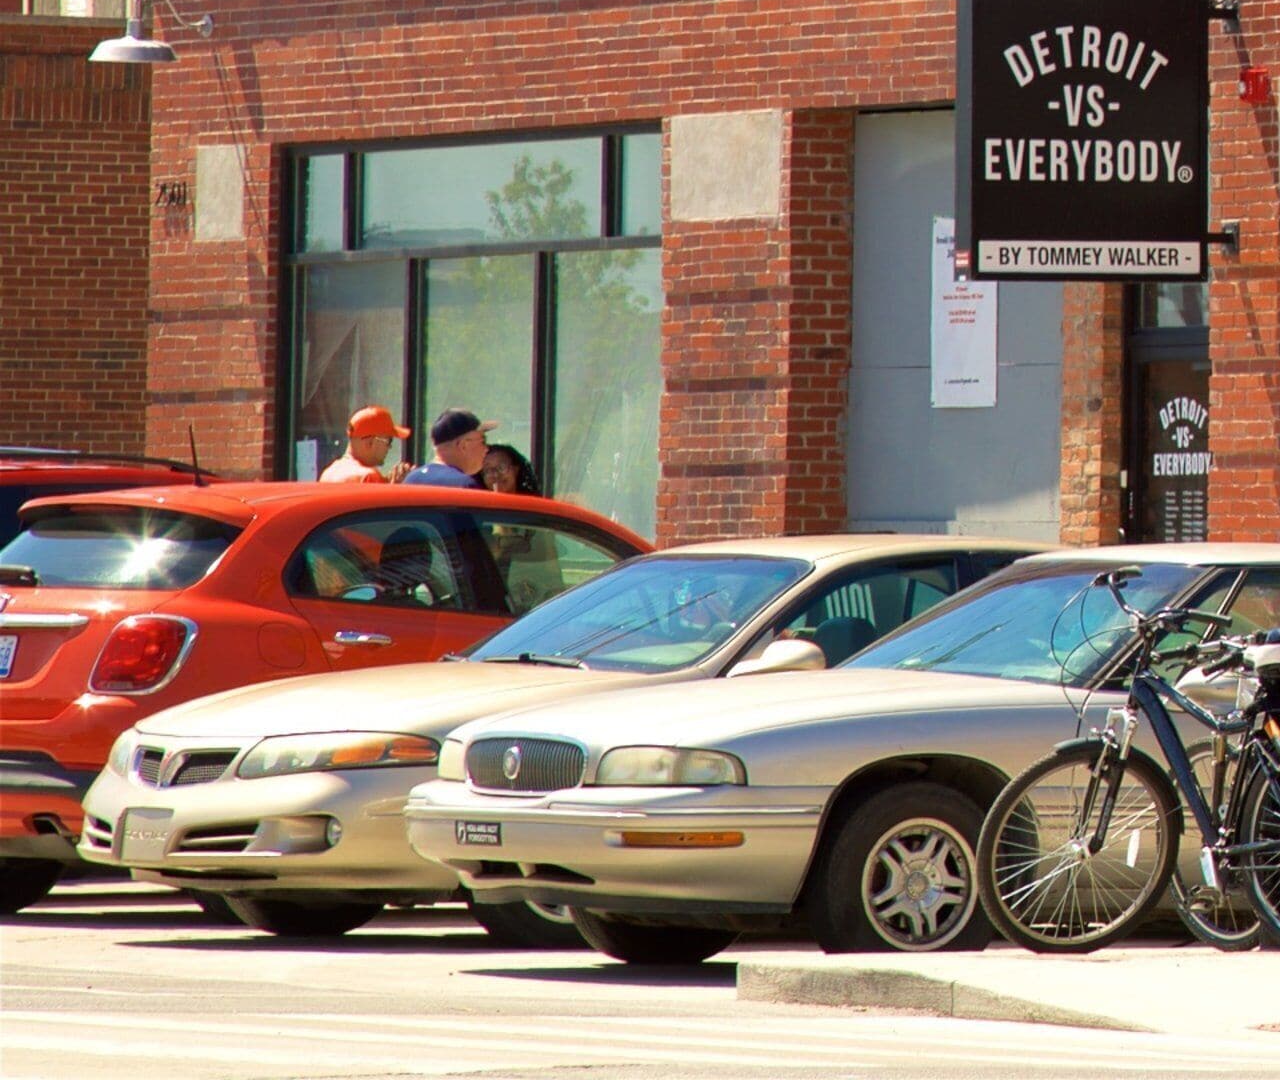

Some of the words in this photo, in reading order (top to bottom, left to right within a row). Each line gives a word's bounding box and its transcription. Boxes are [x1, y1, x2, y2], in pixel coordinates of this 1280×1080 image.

[1003, 25, 1170, 90] DETROIT
[1000, 247, 1022, 266] BY
[1027, 247, 1103, 267] TOMMEY
[1108, 248, 1179, 268] WALKER
[1159, 397, 1208, 430] DETROIT
